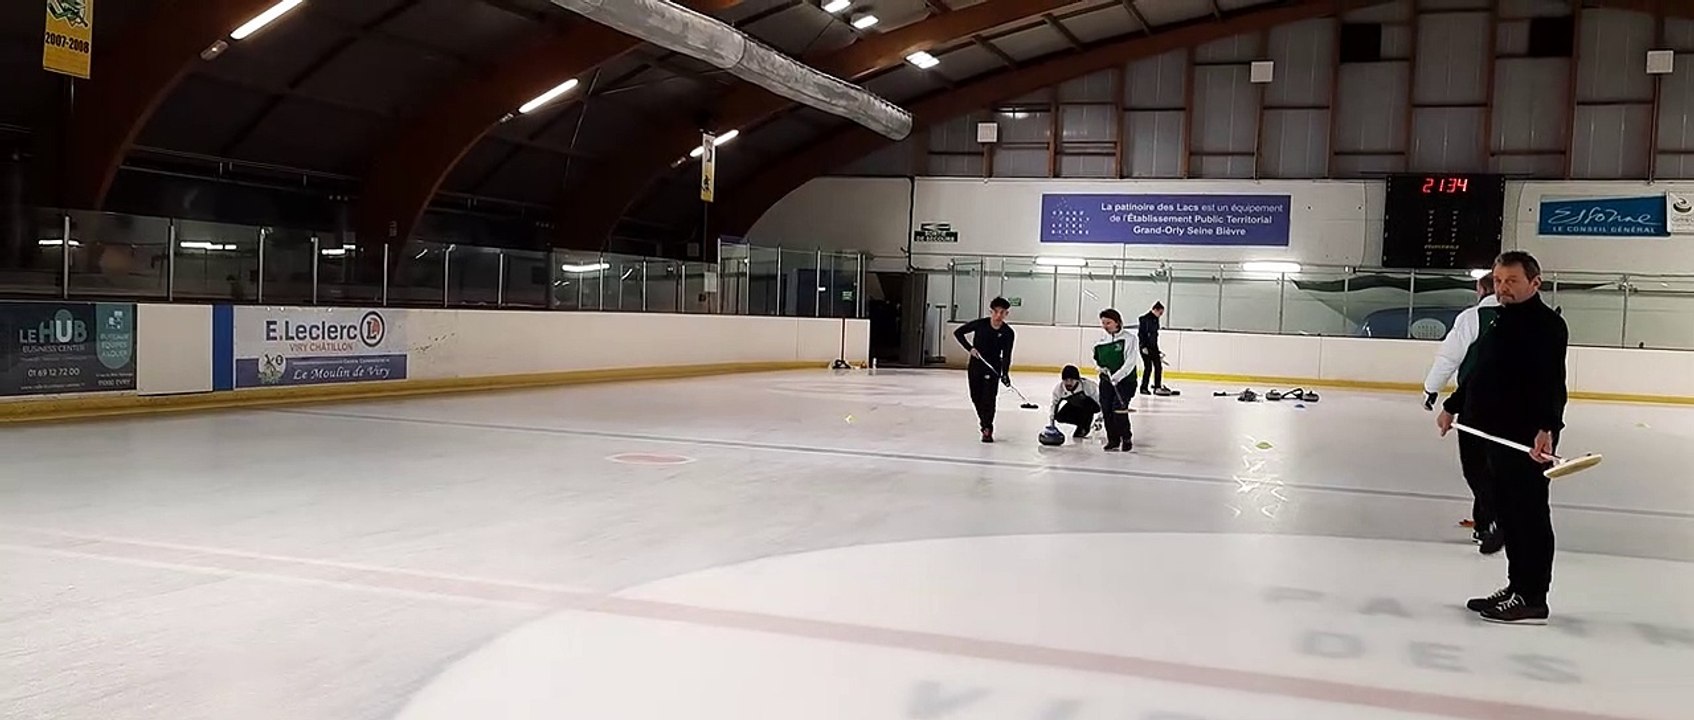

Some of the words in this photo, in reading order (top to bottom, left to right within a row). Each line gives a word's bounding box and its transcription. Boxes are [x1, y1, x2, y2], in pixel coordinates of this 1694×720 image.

[45, 32, 90, 54] 2007-2008
[1101, 203, 1112, 211] La
[1114, 203, 1155, 212] patinoire
[1157, 203, 1174, 211] des
[1177, 203, 1199, 212] Lacs
[1201, 204, 1215, 212] est
[1217, 204, 1229, 212] un
[1231, 204, 1284, 214] équipement
[1109, 214, 1121, 223] de
[1122, 213, 1192, 223] l'Établissement
[1195, 214, 1224, 224] Public
[1227, 215, 1273, 224] Territorial
[1548, 207, 1661, 225] Essonne
[1133, 226, 1185, 236] Grand-Orly
[1187, 226, 1214, 235] Seine
[1216, 226, 1247, 236] Bièvre
[1610, 225, 1656, 233] GÉNÉRAL
[19, 329, 37, 343] LE
[39, 318, 88, 343] HUB
[265, 320, 358, 341] E.Leclerc
[289, 342, 307, 352] VIRY
[28, 368, 37, 377] 01
[38, 368, 48, 377] 69
[49, 367, 58, 376] 12
[59, 367, 68, 376] 72
[68, 367, 80, 376] 00
[293, 369, 308, 380] Le
[311, 366, 350, 379] Moulin
[352, 364, 364, 377] de
[366, 364, 391, 379] Viry
